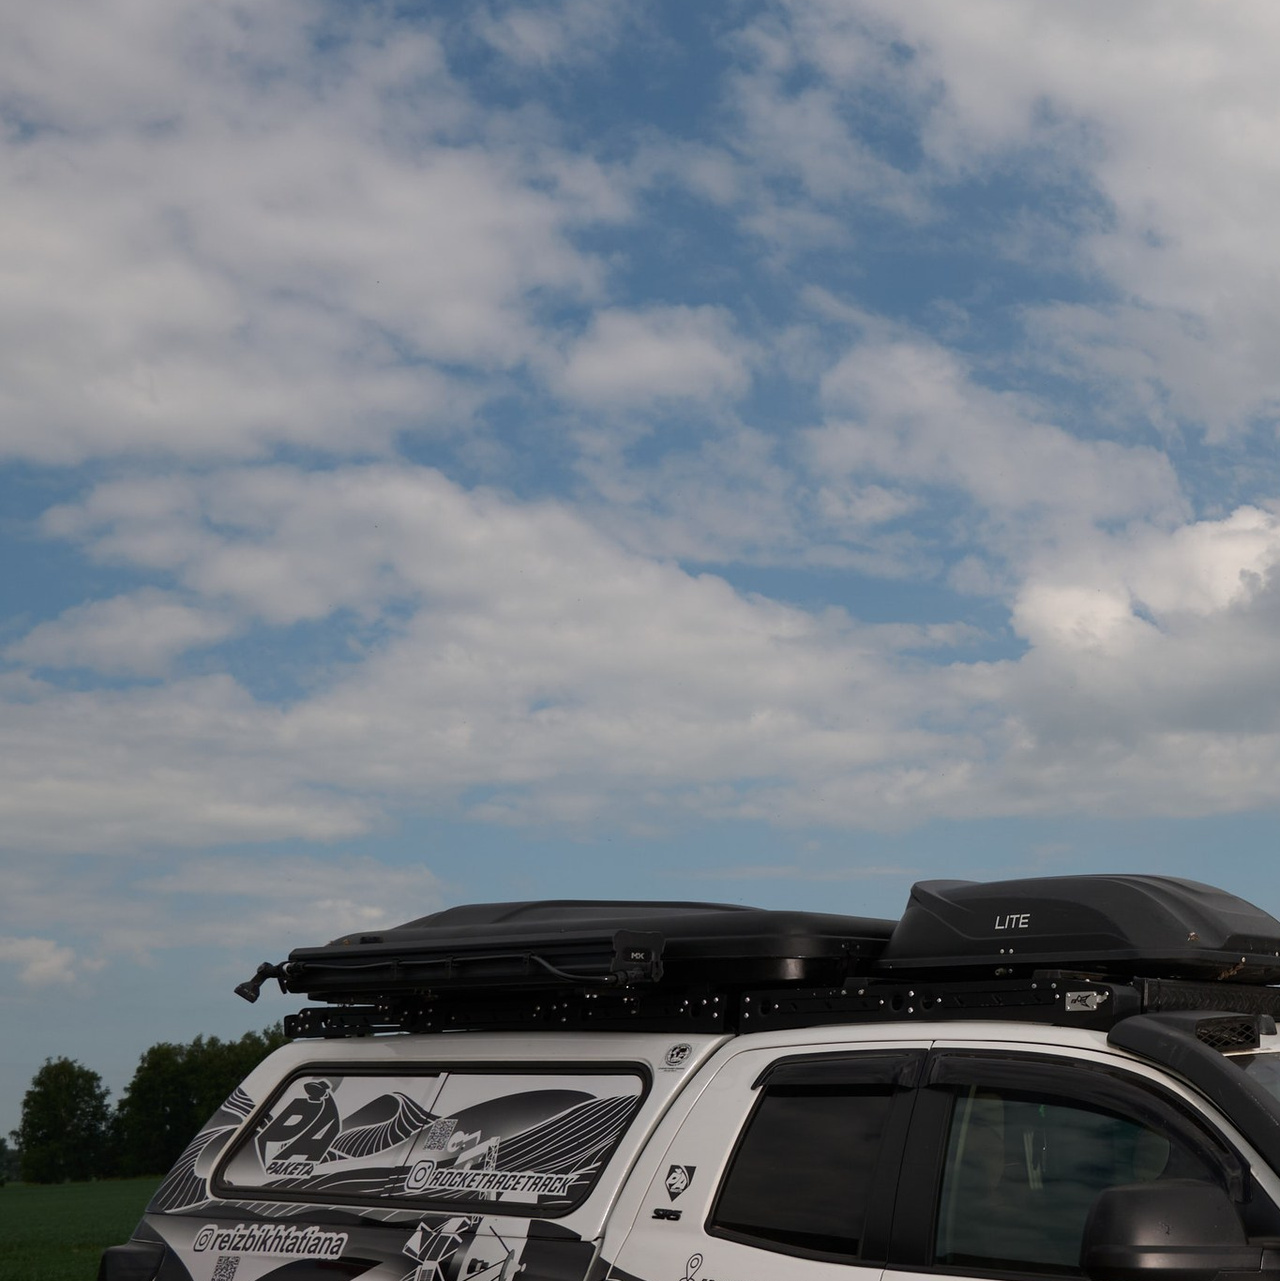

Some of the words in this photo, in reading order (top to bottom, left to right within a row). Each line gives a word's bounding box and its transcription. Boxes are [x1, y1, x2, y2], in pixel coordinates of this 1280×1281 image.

[994, 913, 1031, 930] LITE
[265, 1162, 315, 1177] РАКЕТА
[429, 1171, 576, 1194] ROCKETRACETRACK
[209, 1227, 346, 1256] reizbikhtatiana
